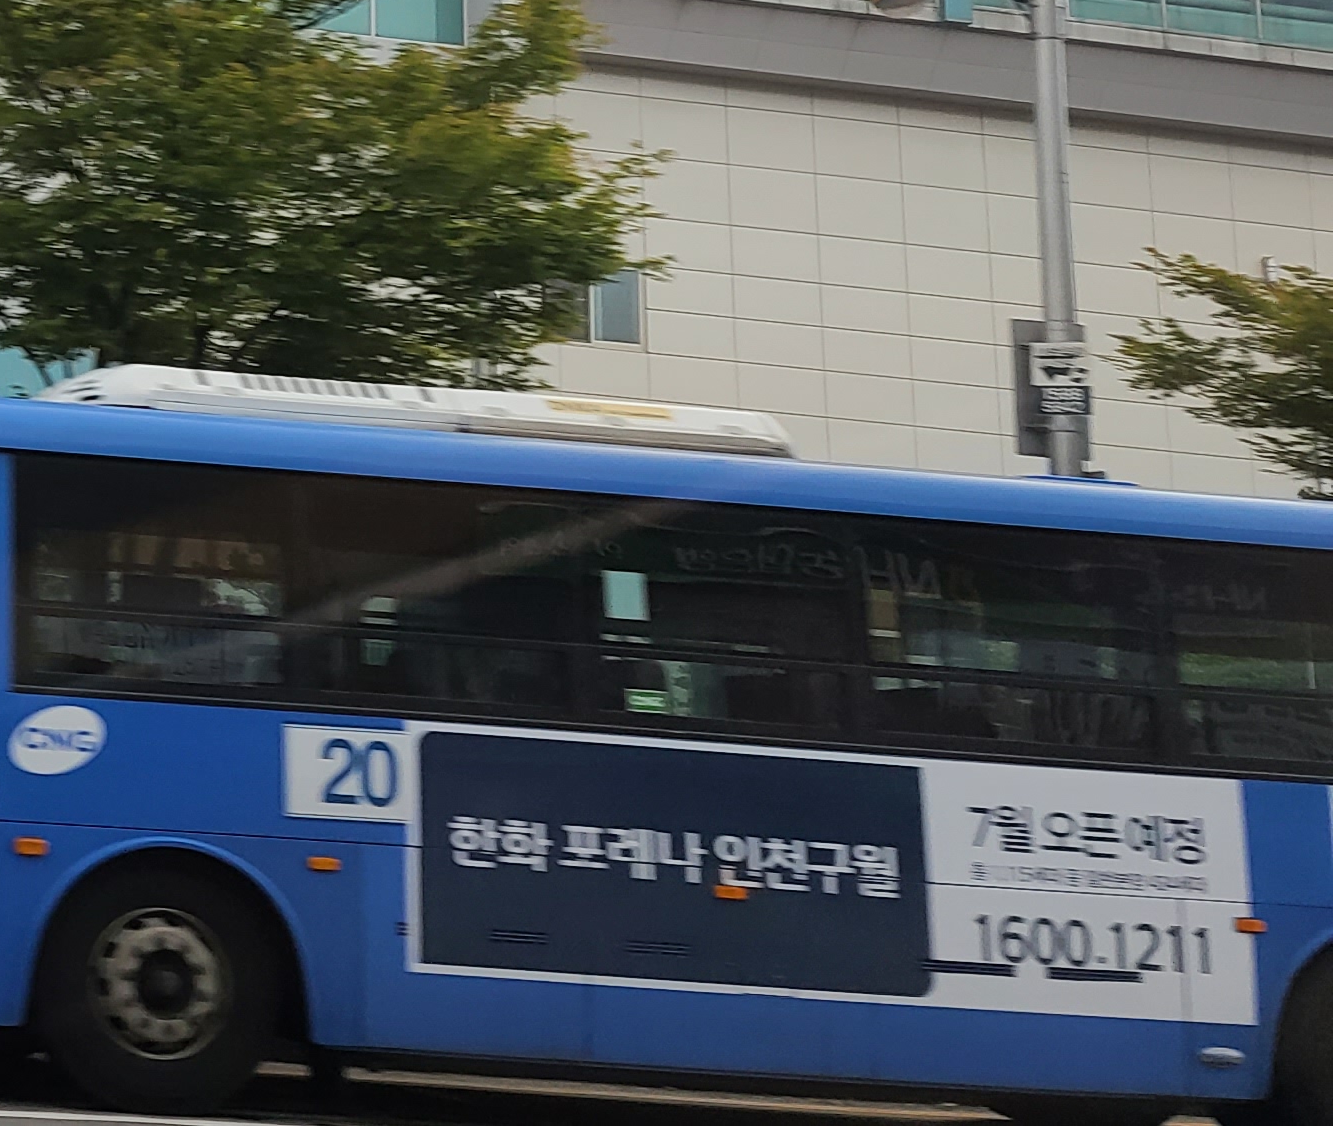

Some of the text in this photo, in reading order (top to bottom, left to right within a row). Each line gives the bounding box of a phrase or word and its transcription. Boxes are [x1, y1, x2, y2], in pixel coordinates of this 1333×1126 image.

[320, 737, 399, 807] 20
[447, 815, 555, 872] 한화
[557, 824, 709, 884] 포레나
[712, 834, 902, 899] 인천구월
[965, 805, 1036, 854] 7월
[973, 914, 1213, 975] 1600.1211
